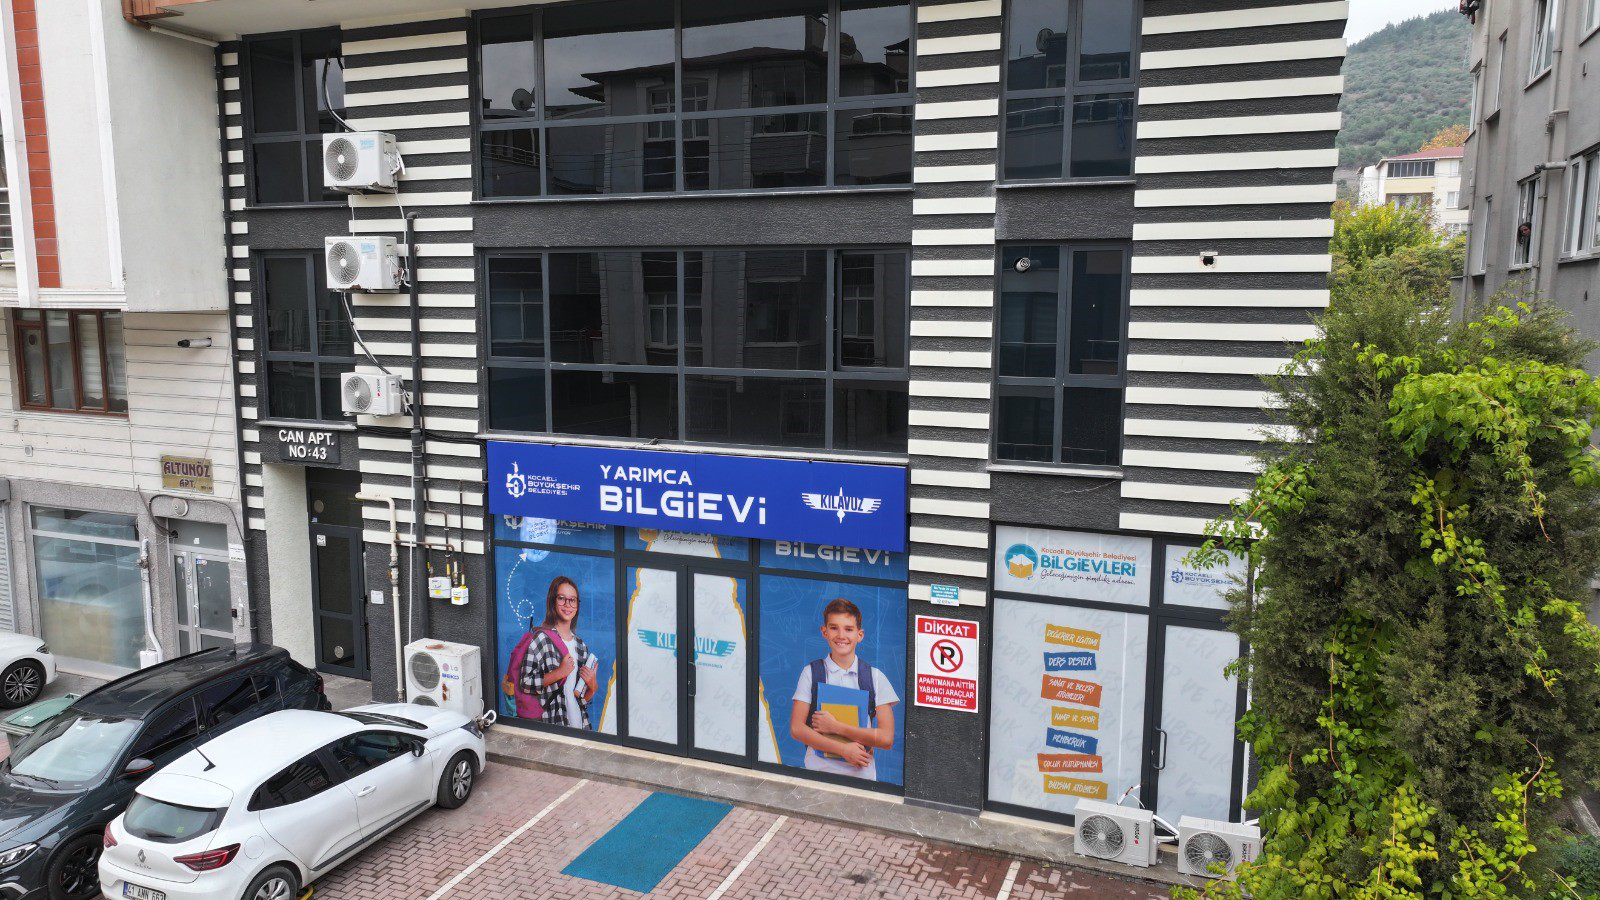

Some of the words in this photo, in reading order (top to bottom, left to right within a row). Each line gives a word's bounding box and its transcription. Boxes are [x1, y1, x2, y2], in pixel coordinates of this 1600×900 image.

[278, 429, 304, 443] CAN
[308, 432, 335, 446] APT.
[288, 445, 327, 460] NO:43
[163, 461, 211, 478] ALTUNÖZ
[600, 465, 693, 486] YARIMCA
[820, 494, 864, 512] KILAVUZ
[1041, 547, 1065, 556] Kocaeli
[1103, 552, 1137, 562] Belediyesi
[924, 621, 970, 637] DİKKAT
[1048, 657, 1066, 667] DERS
[1068, 656, 1092, 666] DESTEK
[918, 676, 955, 688] APARTMANA
[956, 680, 976, 690] AİTTİR
[918, 685, 945, 695] YABANCI
[945, 688, 975, 699] ARAÇLAR
[925, 695, 942, 704] PARK
[943, 697, 967, 707] EDEMEZ
